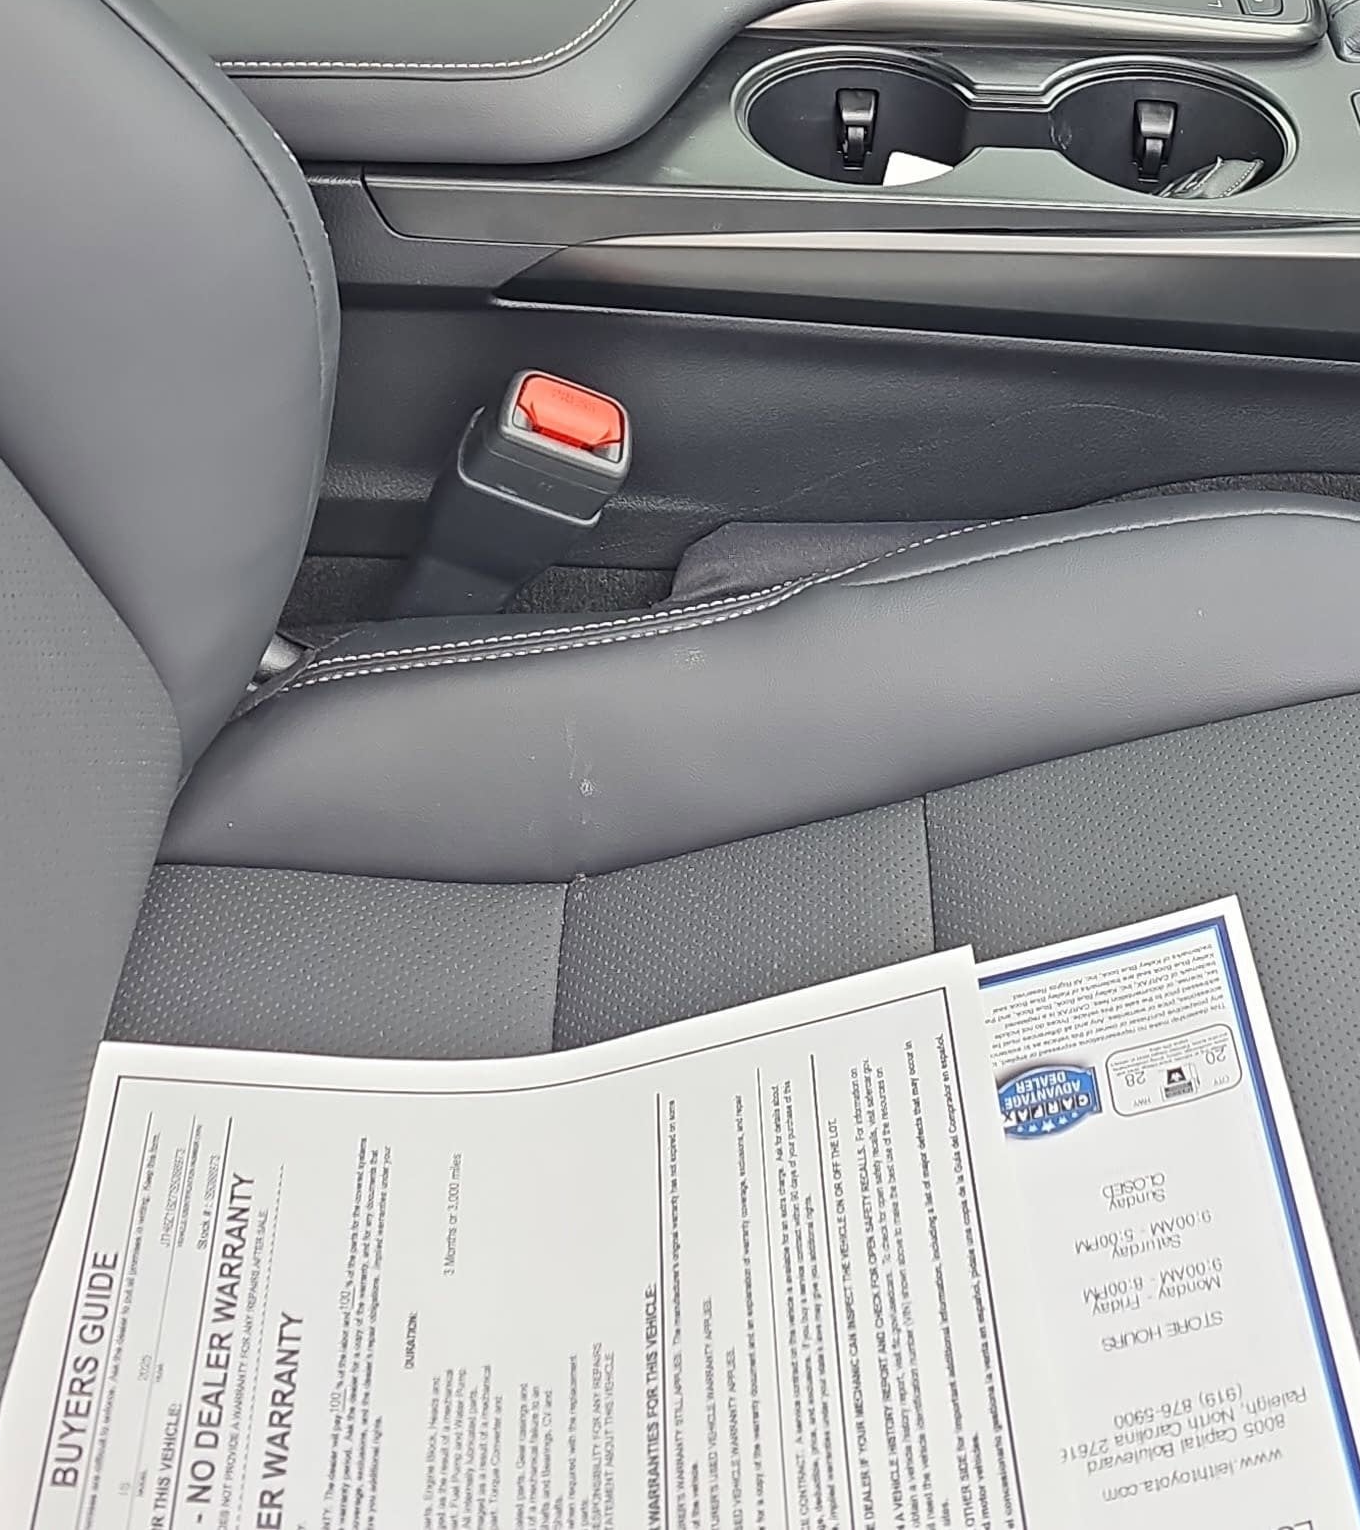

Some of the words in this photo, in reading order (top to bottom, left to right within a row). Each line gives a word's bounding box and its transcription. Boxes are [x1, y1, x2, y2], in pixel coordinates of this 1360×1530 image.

[1202, 1046, 1226, 1065] 20
[1012, 1069, 1067, 1093] DEALER
[1124, 1070, 1146, 1087] 28
[1002, 1079, 1080, 1110] ADVANTAGE
[1002, 1090, 1094, 1124] CARFAX
[829, 1139, 840, 1159] THE
[449, 1153, 461, 1179] miles
[831, 1160, 841, 1180] OFF
[833, 1181, 843, 1197] OR
[1102, 1172, 1165, 1198] CLOSED
[835, 1198, 845, 1214] ON
[1105, 1188, 1165, 1211] Sunday
[448, 1212, 457, 1224] or
[1150, 1209, 1211, 1236] 9:00AM
[196, 1219, 210, 1250] Stock
[211, 1172, 254, 1323] WARRANTY
[443, 1227, 457, 1266] Months
[836, 1214, 849, 1260] VEHICLE
[1074, 1228, 1133, 1254] 5:00PM
[1106, 1233, 1181, 1259] Saturday
[840, 1260, 851, 1284] THE
[1159, 1257, 1222, 1285] 9:00AM
[1082, 1276, 1143, 1303] 8:00PM
[1158, 1274, 1221, 1300] Monday
[644, 1282, 657, 1349] VEHICLE:
[843, 1285, 856, 1330] INSPECT
[1085, 1292, 1140, 1316] Friday
[1165, 1310, 1223, 1337] STORE
[847, 1332, 858, 1357] CAN
[1101, 1325, 1162, 1352] HOURS
[49, 1355, 99, 1487] BUYERS
[78, 1251, 118, 1344] GUIDE
[645, 1350, 658, 1384] THIS
[194, 1331, 233, 1449] DEALER
[261, 1311, 303, 1479] WARRANTY
[645, 1384, 658, 1418] FOR
[849, 1357, 864, 1418] MECHANIC
[1198, 1382, 1242, 1407] (919)
[1240, 1385, 1306, 1415] Raleigh,
[1113, 1397, 1192, 1430] 876-5900
[1187, 1405, 1235, 1431] North
[1242, 1413, 1285, 1438] 8005
[159, 1403, 182, 1471] VEHICLE:
[220, 1482, 232, 1507] NOT
[231, 1361, 248, 1420] WARRANTY
[855, 1420, 867, 1455] YOUR
[1113, 1421, 1182, 1446] Carolina
[1175, 1426, 1237, 1454] Capital
[646, 1421, 660, 1523] WARRANTIES
[858, 1457, 869, 1468] IF
[1101, 1447, 1282, 1501] www.leithtoyota.com
[153, 1476, 171, 1510] THIS
[186, 1459, 215, 1503] NO
[859, 1469, 874, 1520] DEALER
[256, 1488, 284, 1530] ER
